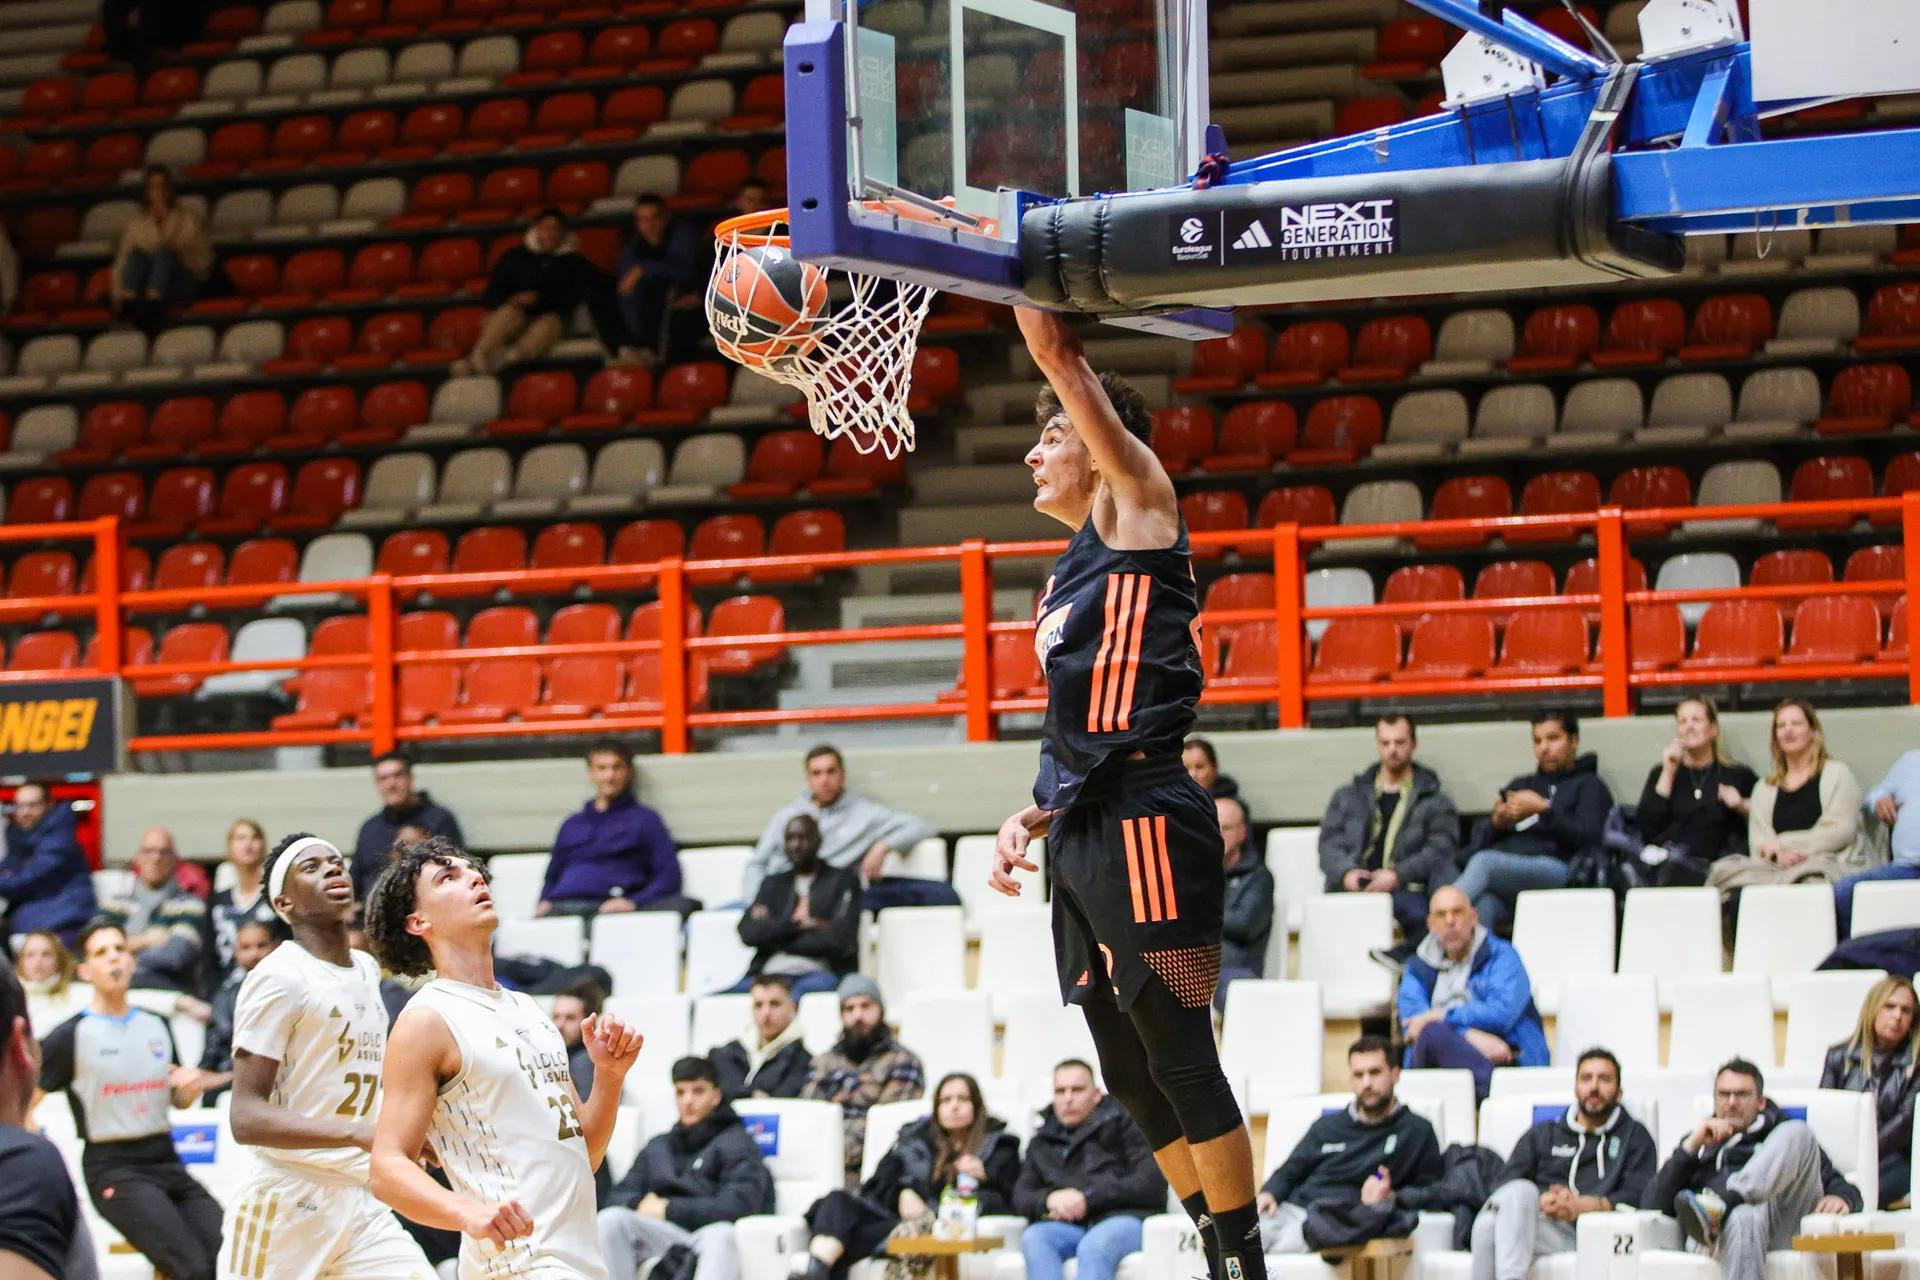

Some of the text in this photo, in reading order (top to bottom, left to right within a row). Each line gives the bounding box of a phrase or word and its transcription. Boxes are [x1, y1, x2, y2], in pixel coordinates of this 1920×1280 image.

[1281, 200, 1393, 229] NEXT
[1282, 221, 1393, 246] GENERATION
[1282, 242, 1393, 260] TOURNAMENT
[0, 697, 97, 755] NGE!
[336, 1072, 378, 1116] 27
[547, 1094, 584, 1141] 23
[1178, 1231, 1197, 1252] 24
[1613, 1233, 1633, 1255] 22
